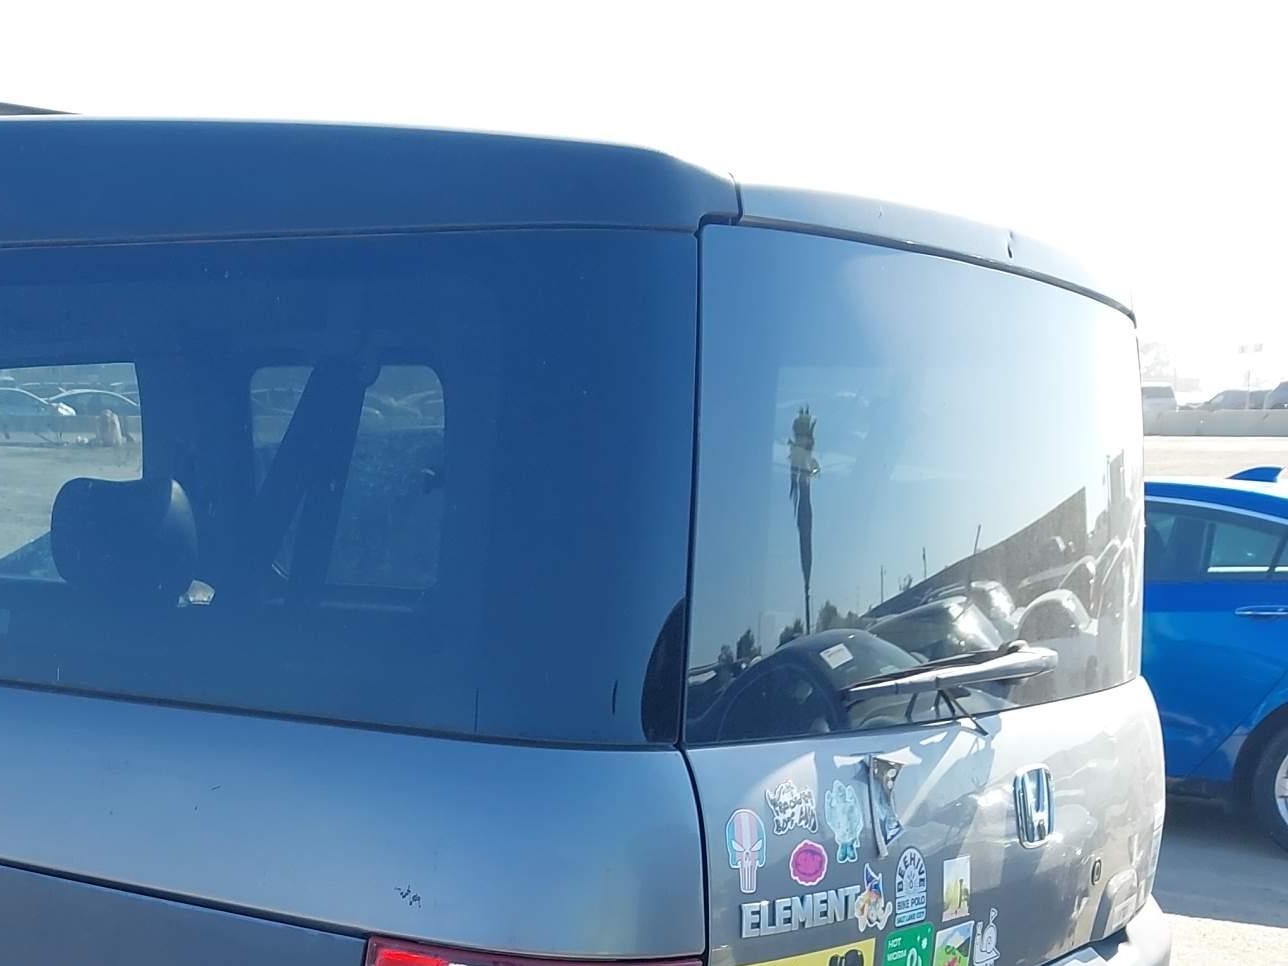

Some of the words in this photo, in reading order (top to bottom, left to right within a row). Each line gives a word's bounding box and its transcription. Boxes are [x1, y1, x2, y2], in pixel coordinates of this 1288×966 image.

[897, 852, 926, 893] BEEHIVE
[910, 895, 925, 907] POLO
[741, 885, 861, 938] ELEMENT
[887, 937, 902, 949] HOT
[887, 949, 907, 961] WORM
